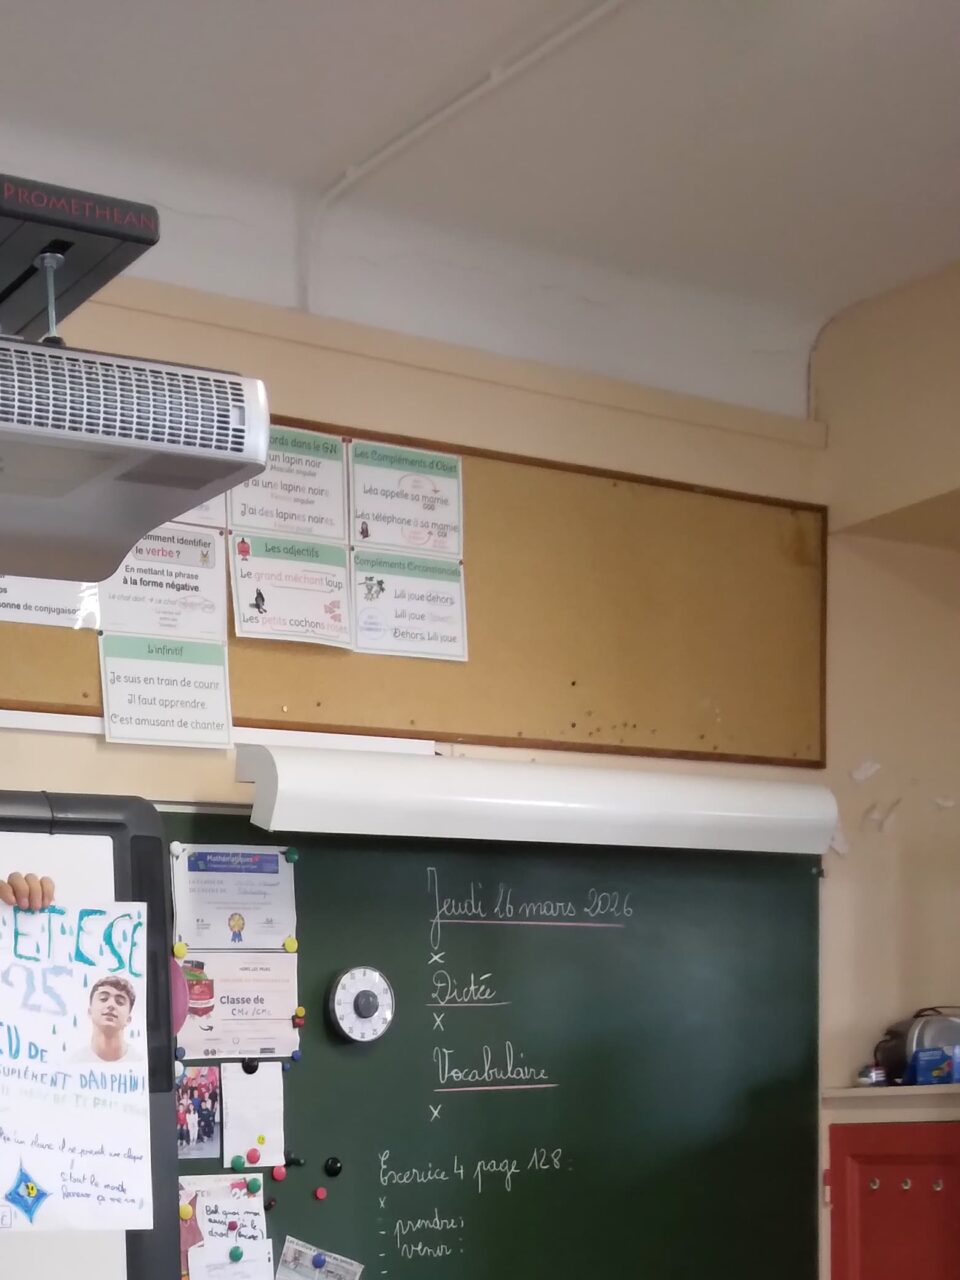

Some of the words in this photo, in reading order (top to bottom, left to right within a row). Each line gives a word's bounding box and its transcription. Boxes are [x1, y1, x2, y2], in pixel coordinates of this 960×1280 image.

[3, 182, 155, 230] PROMETHEAN
[282, 452, 303, 466] lapin
[305, 458, 322, 469] noir
[380, 488, 409, 500] appelle
[176, 537, 211, 548] identifier
[265, 542, 281, 554] Les
[282, 545, 320, 559] adjectifs
[135, 545, 144, 554] le
[144, 546, 174, 559] verbe
[125, 564, 135, 573] En
[166, 568, 174, 577] la
[175, 570, 199, 581] phrase
[240, 567, 253, 579] Le
[122, 575, 129, 585] à
[129, 576, 138, 586] la
[140, 577, 164, 588] forme
[22, 602, 33, 611] de
[242, 612, 260, 624] Les
[110, 671, 122, 685] Je
[123, 674, 141, 685] suis
[143, 677, 155, 686] en
[157, 676, 178, 687] train
[180, 677, 192, 688] de
[138, 694, 157, 706] faut
[110, 713, 133, 726] C'est
[134, 717, 175, 728] amusant
[177, 718, 189, 729] de
[427, 867, 488, 950] Jeudi
[519, 899, 576, 918] mars
[220, 995, 252, 1005] Classe
[253, 995, 265, 1005] de
[28, 1041, 49, 1064] DE
[432, 1040, 549, 1084] Vocabulaire
[453, 1155, 464, 1181] 4
[473, 1158, 520, 1194] page
